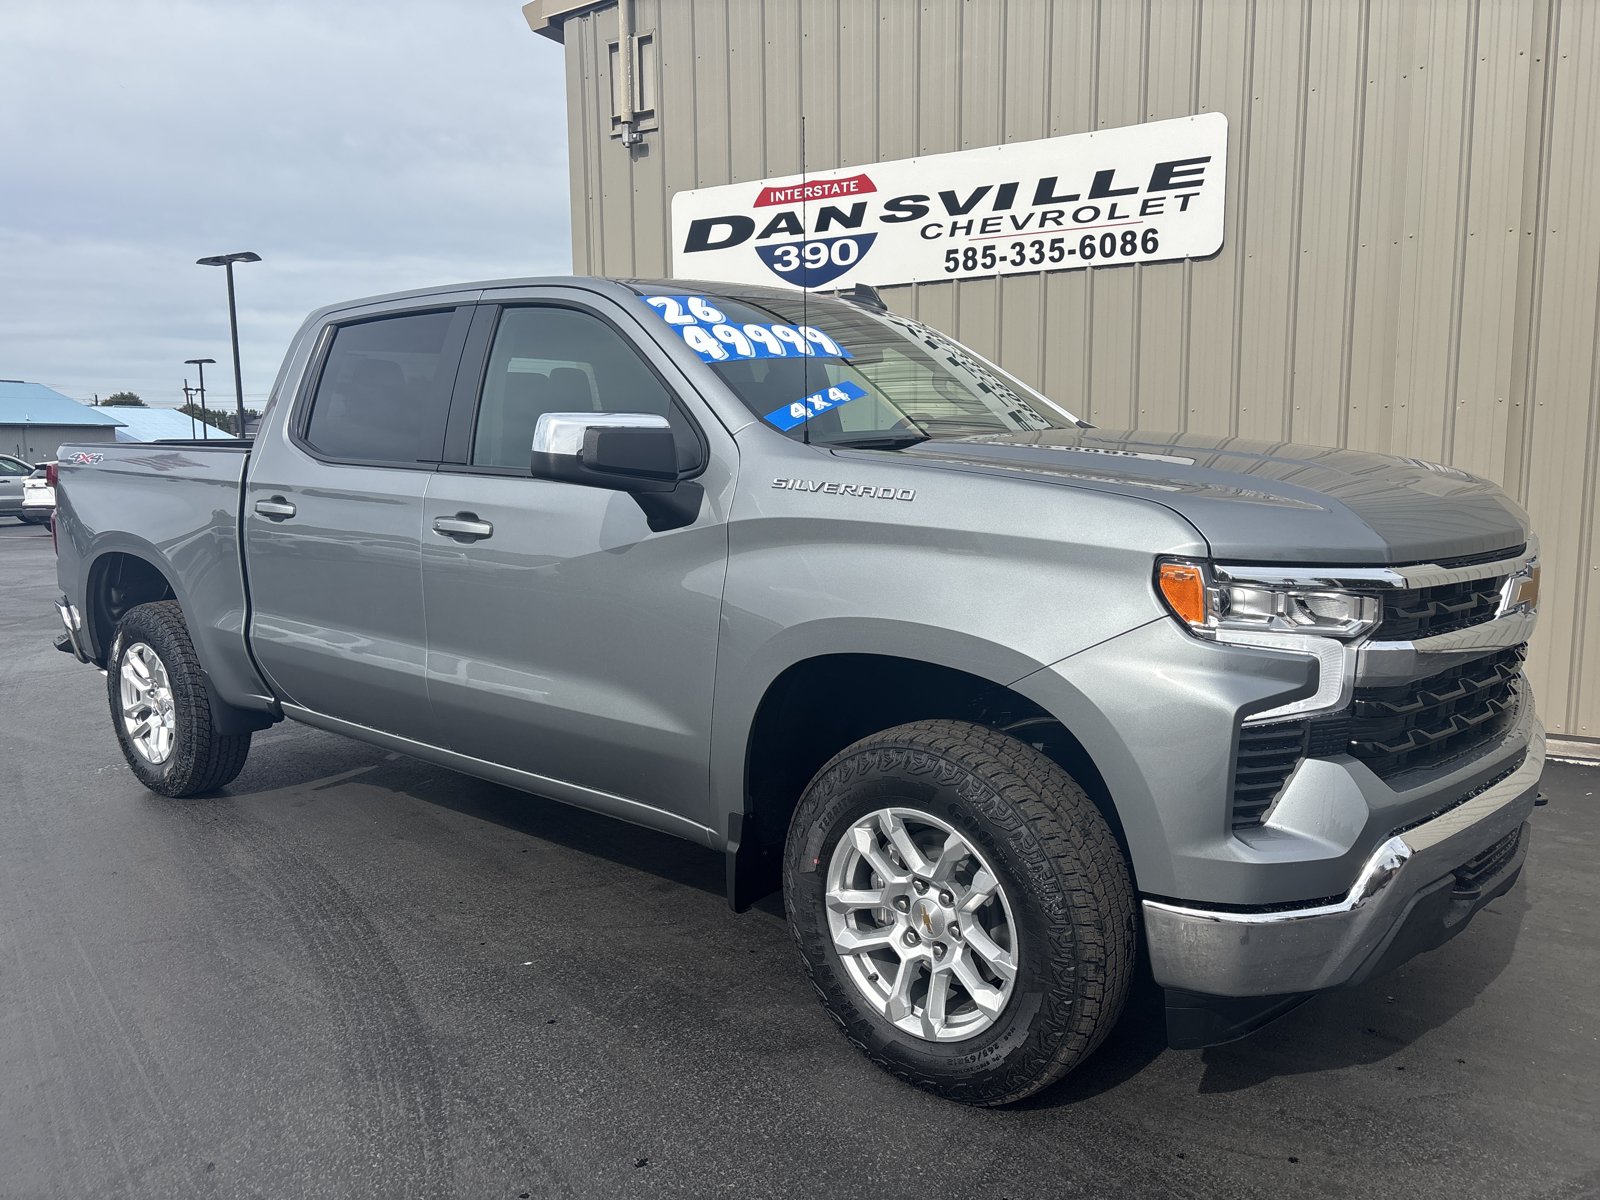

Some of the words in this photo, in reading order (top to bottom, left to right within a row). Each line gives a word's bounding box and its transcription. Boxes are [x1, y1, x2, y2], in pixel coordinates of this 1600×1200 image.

[770, 180, 860, 201] INTERSTATE
[920, 192, 1202, 240] CHEVROLET
[773, 238, 859, 272] 390
[944, 227, 1159, 273] 585-335-6086
[646, 295, 727, 326] 26
[683, 323, 842, 361] 49999
[772, 477, 916, 502] SILVERADO
